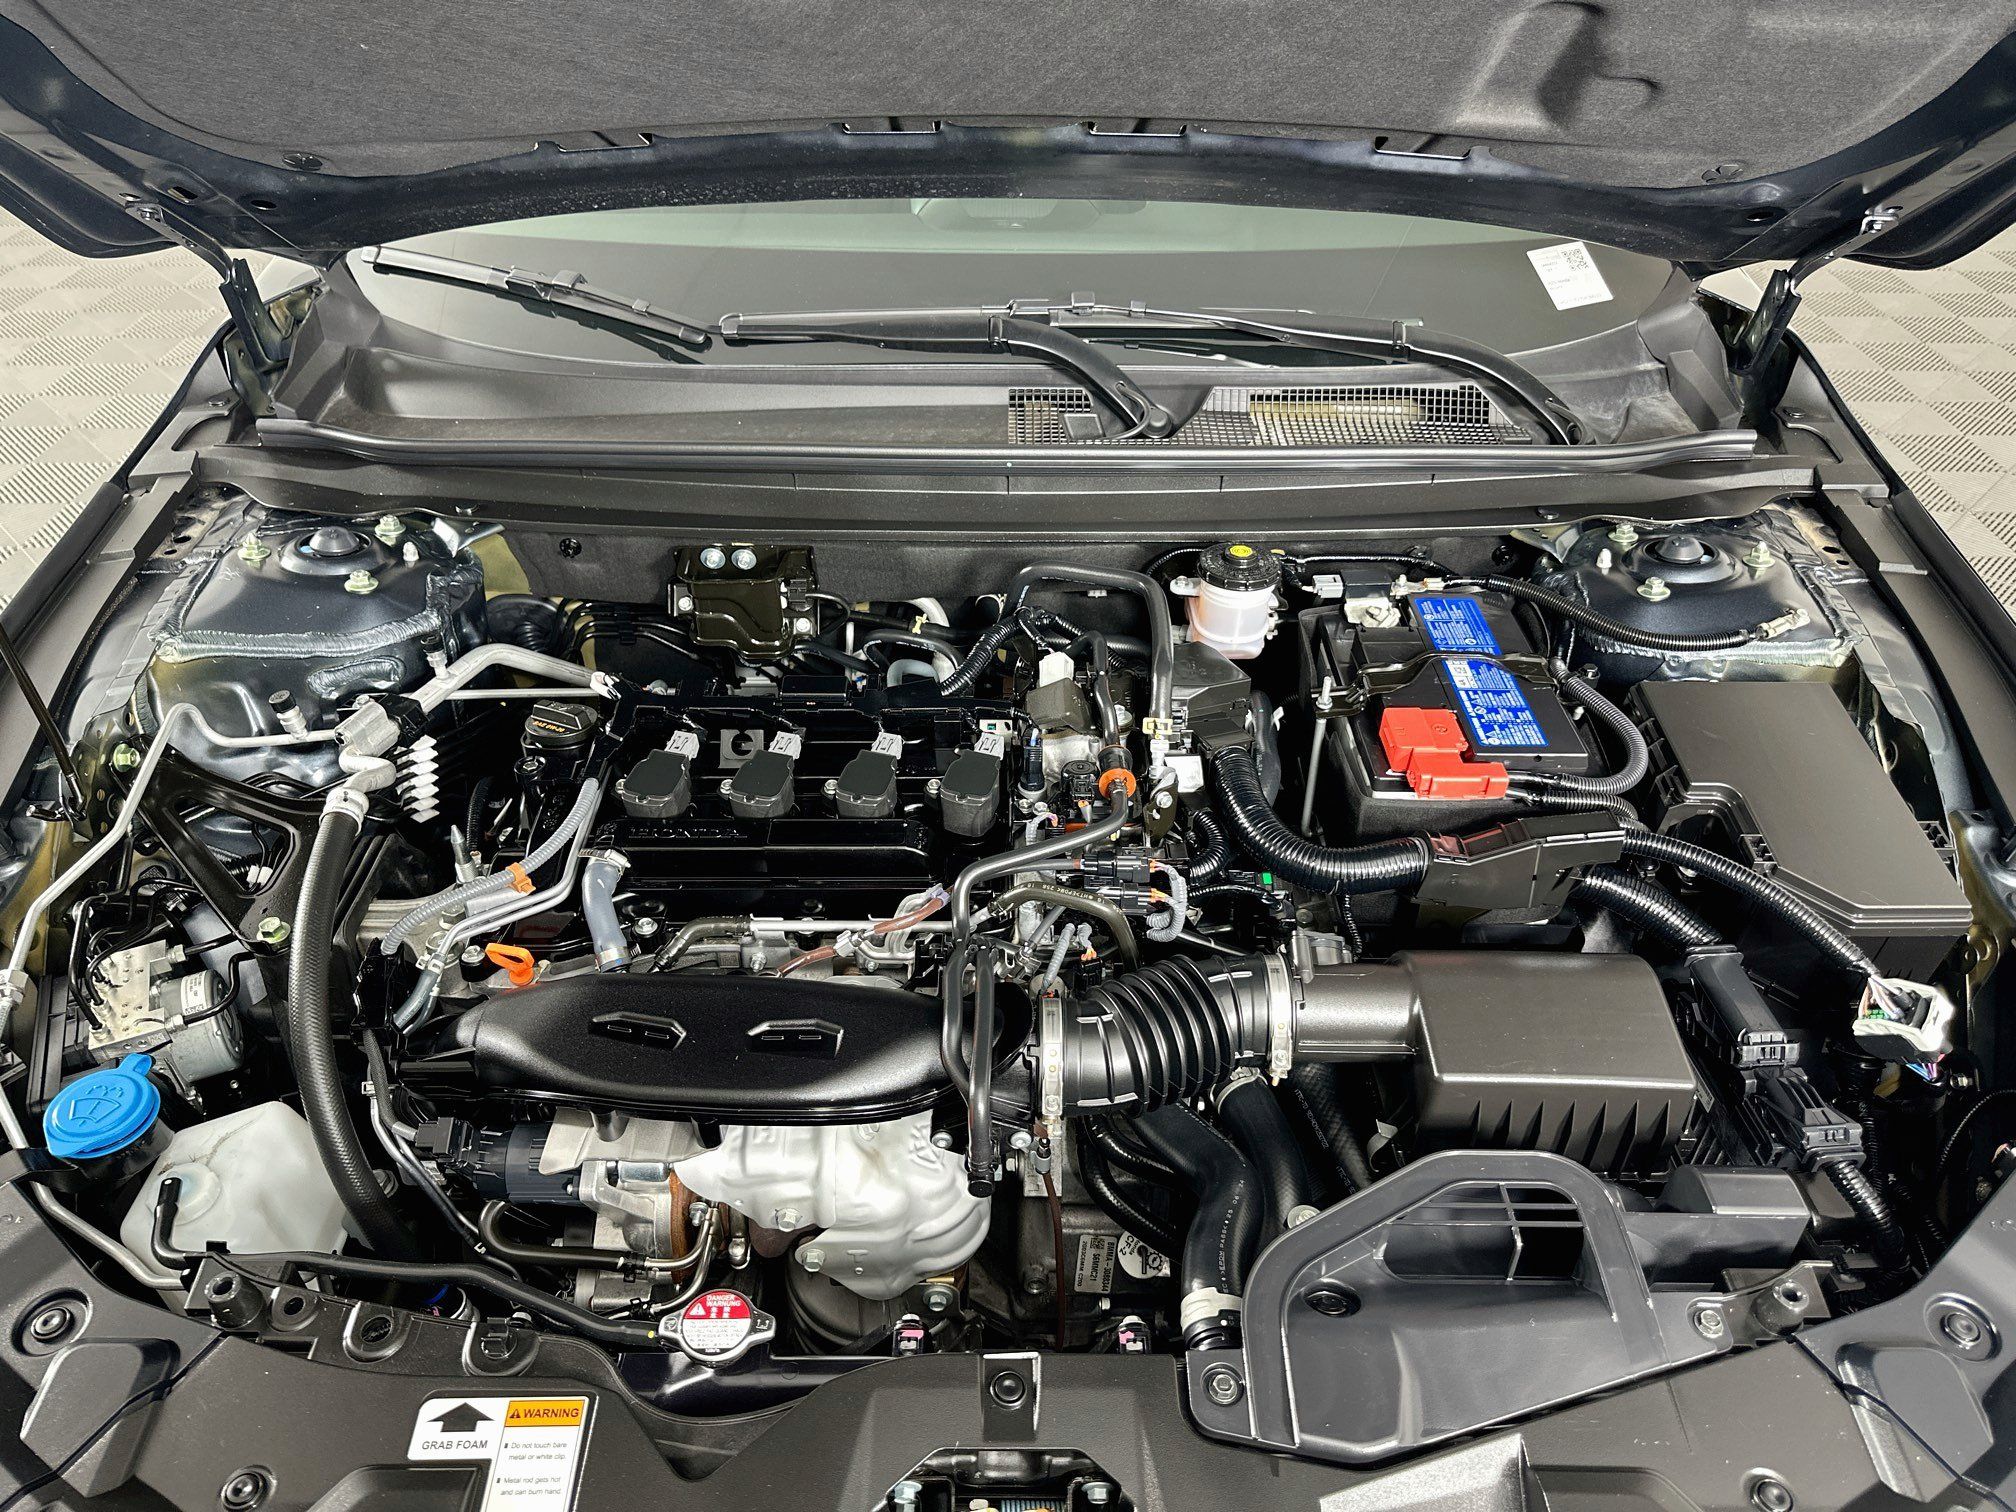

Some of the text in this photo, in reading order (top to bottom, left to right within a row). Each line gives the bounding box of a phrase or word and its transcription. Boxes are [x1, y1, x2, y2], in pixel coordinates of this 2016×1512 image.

[1119, 1235, 1135, 1256] CF-2
[523, 1408, 580, 1419] WARNING
[421, 1440, 488, 1450] GRAB FOAM
